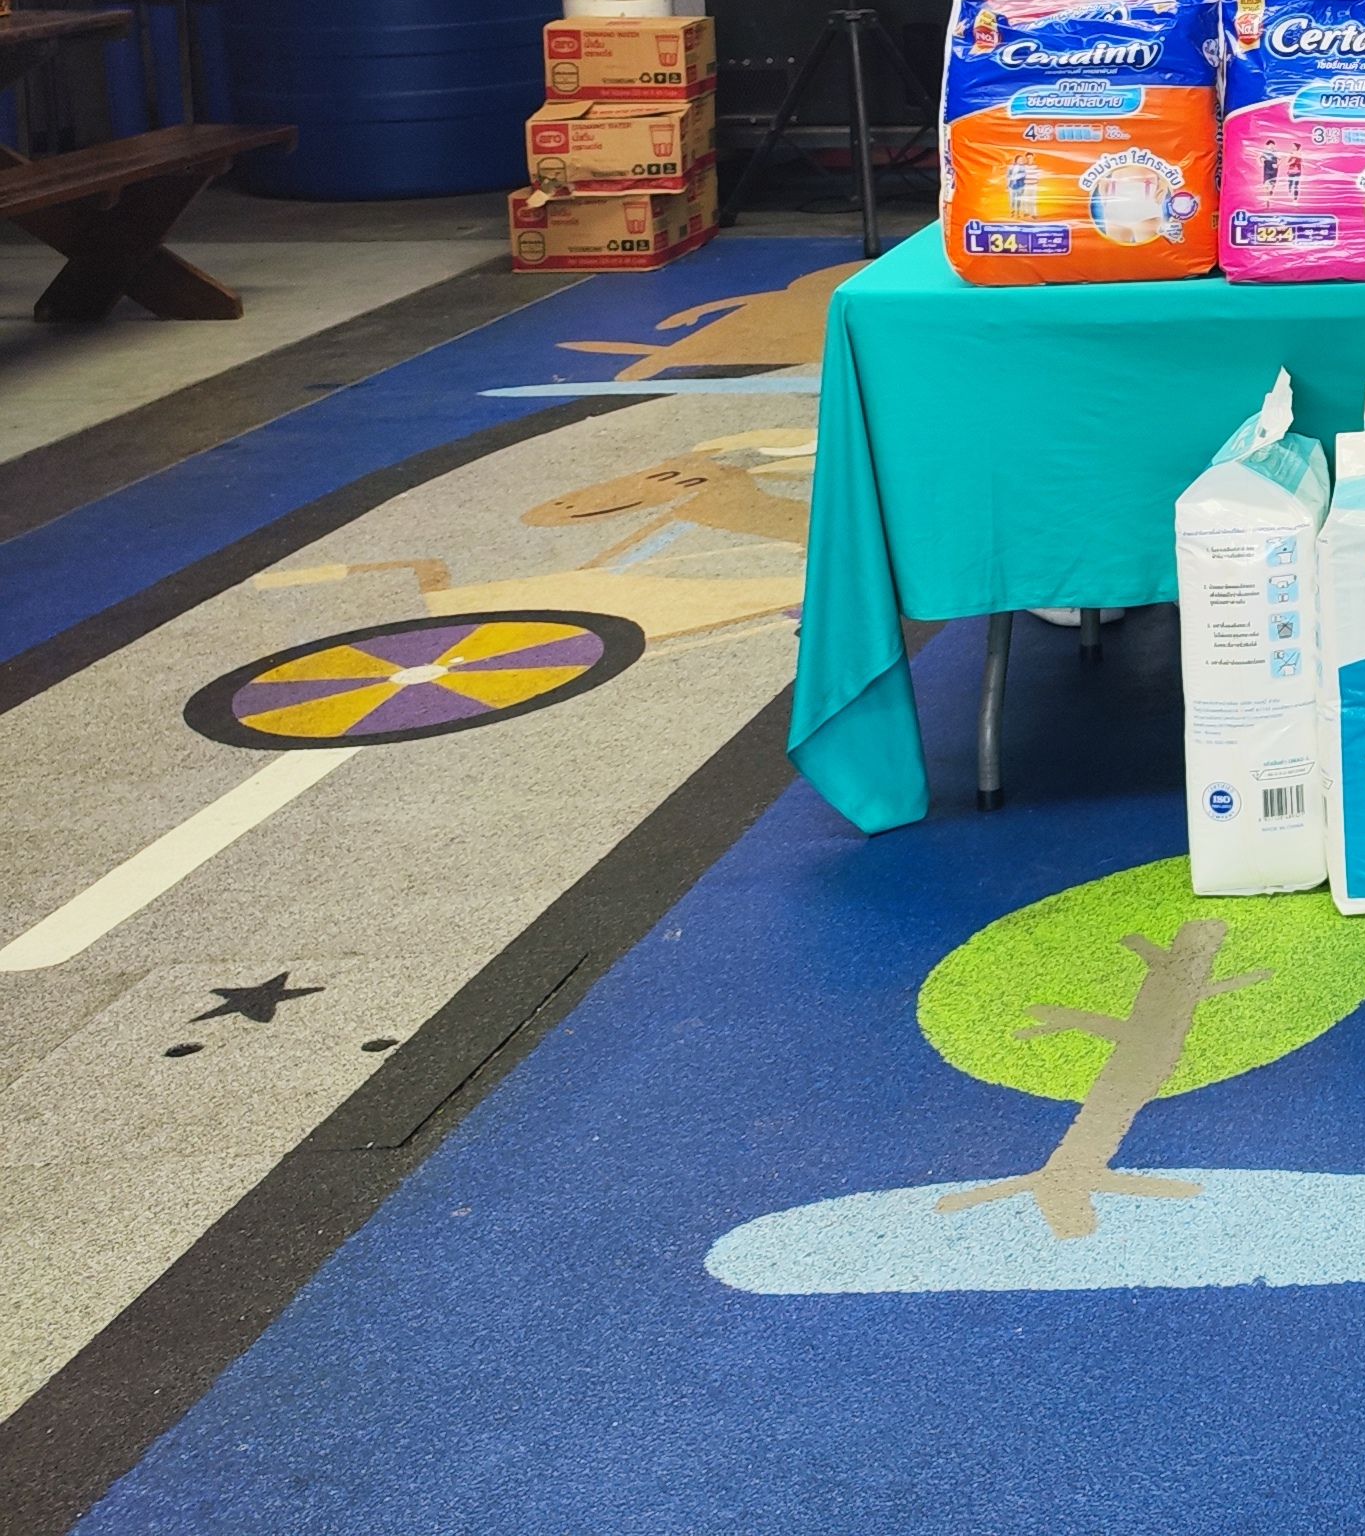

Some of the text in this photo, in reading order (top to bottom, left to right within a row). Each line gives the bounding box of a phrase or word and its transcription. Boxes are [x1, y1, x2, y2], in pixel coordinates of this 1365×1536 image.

[1024, 125, 1037, 141] 4
[1313, 127, 1326, 144] 3
[1082, 149, 1182, 187] สวมง่าย ใส่กระชับ
[970, 233, 1018, 252] L 34
[1235, 226, 1250, 244] L
[1212, 795, 1232, 804] ISO
